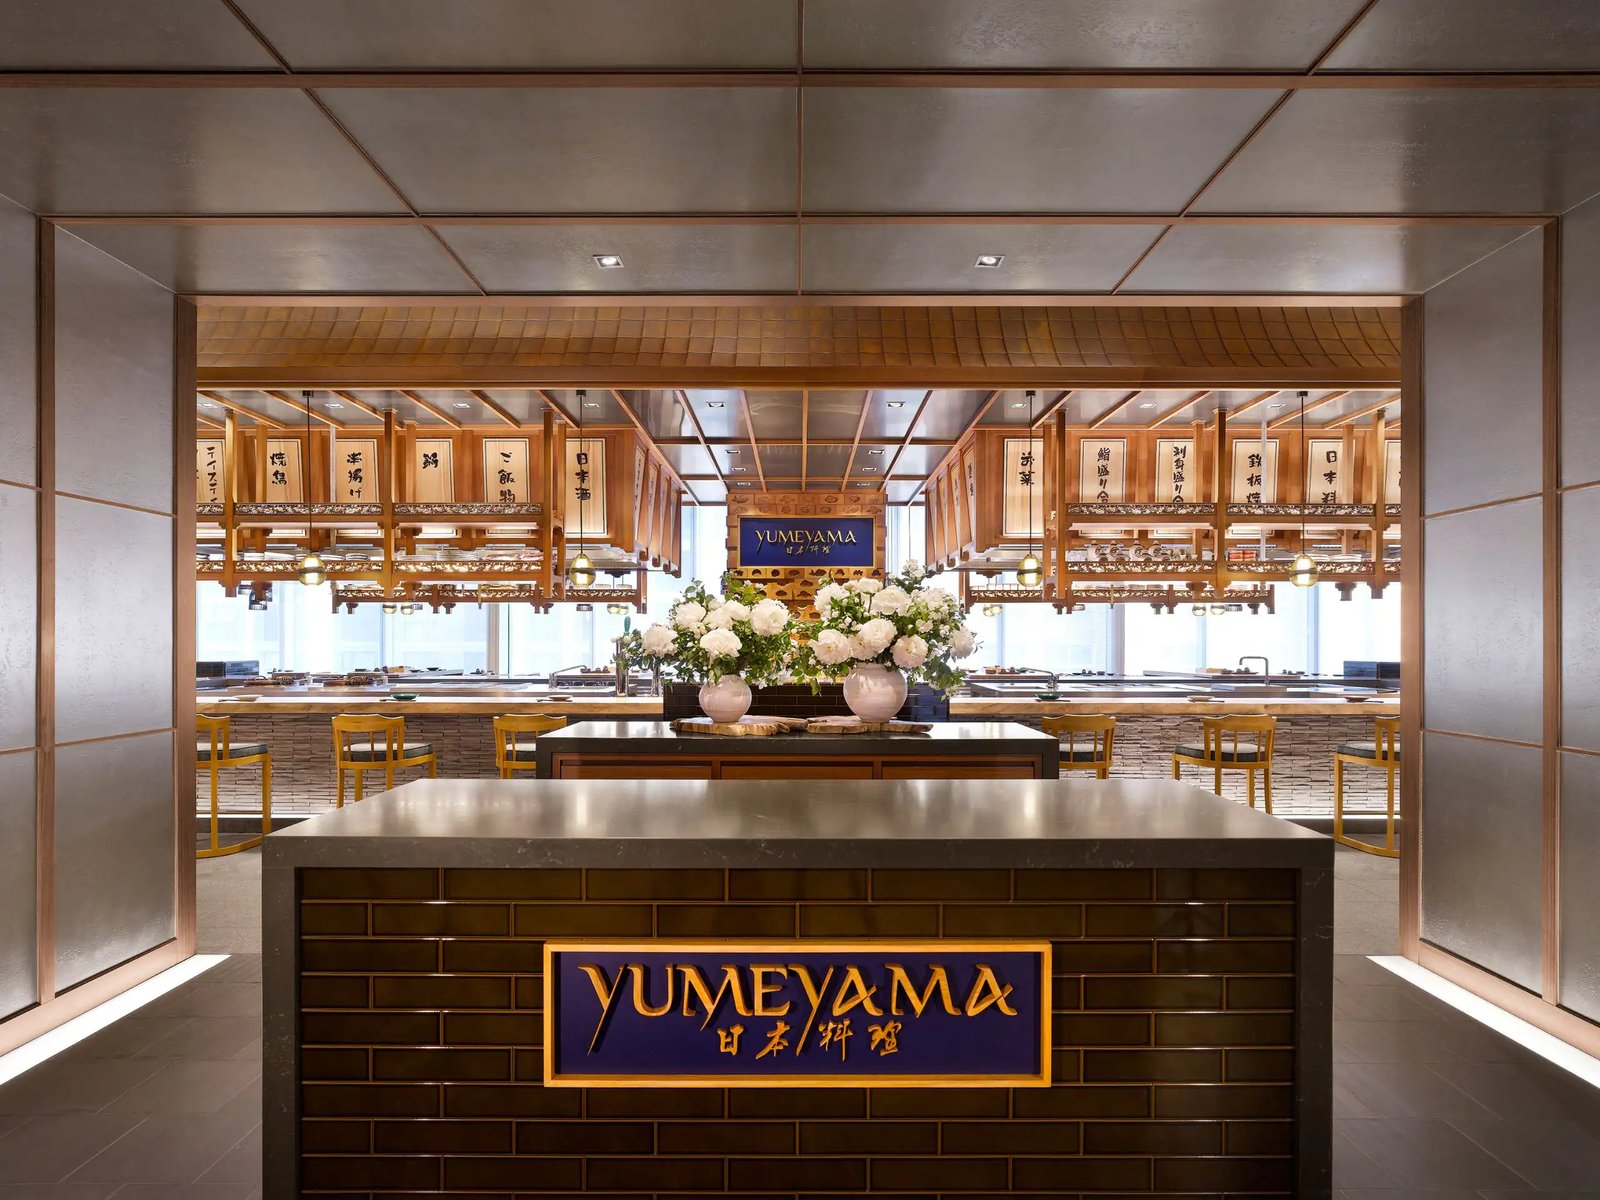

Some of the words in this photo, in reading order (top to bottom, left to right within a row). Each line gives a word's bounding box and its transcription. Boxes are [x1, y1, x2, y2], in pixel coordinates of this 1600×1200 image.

[574, 452, 591, 501] 日本酒
[755, 529, 857, 552] YUMEYAMA
[577, 962, 1018, 1056] YUMEYAMA
[717, 1017, 903, 1062] 日本料理
